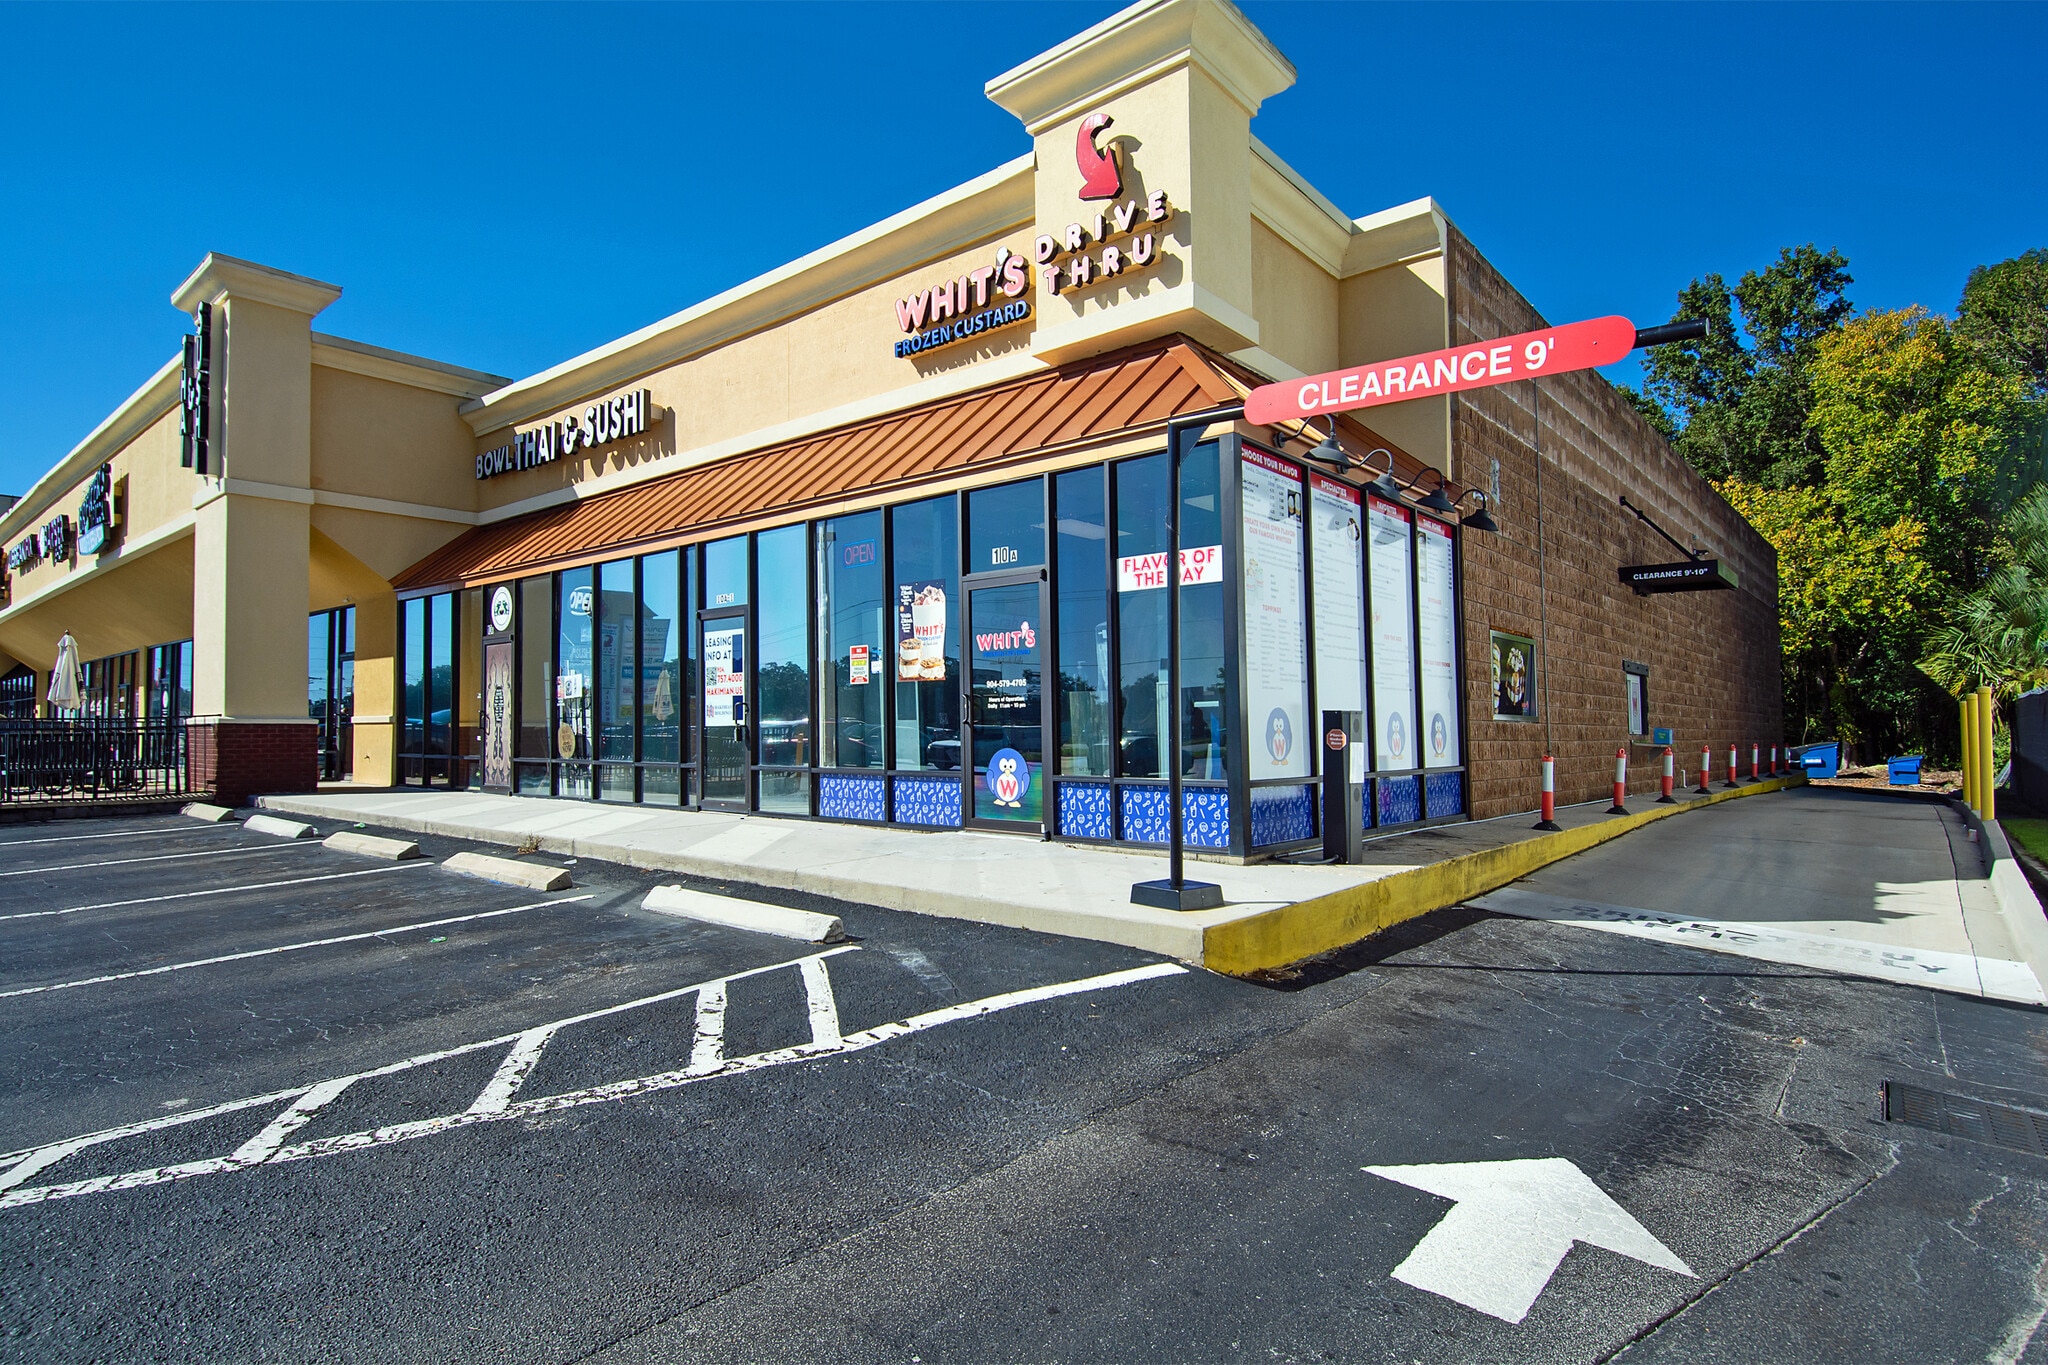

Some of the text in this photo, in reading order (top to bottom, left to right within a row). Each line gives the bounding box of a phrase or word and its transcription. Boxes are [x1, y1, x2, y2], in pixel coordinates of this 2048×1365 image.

[1035, 189, 1168, 264] DRIVE
[1043, 233, 1156, 296] THRU
[895, 246, 1028, 333] WHIT'S
[894, 300, 1028, 358] FROZEN CUSTARD
[1297, 337, 1556, 411] CLEARANCE 9'
[476, 388, 647, 479] BOWL THAI & SUSHI
[1263, 456, 1278, 470] YOUR
[1278, 462, 1298, 478] FLAVOR
[844, 543, 874, 565] OPEN
[1123, 548, 1215, 573] FLAVR OF
[1134, 566, 1204, 587] THE AY
[1633, 570, 1682, 580] CLEARANCE
[914, 623, 944, 637] WHIT'S
[976, 621, 1036, 651] WHIT'S
[705, 636, 732, 647] LEASING
[705, 650, 731, 661] INFO AT
[717, 673, 743, 683] 757.4000
[986, 679, 1027, 688] 904-579-4705
[707, 686, 743, 695] HAKIMIAN.US
[998, 779, 1017, 798] W
